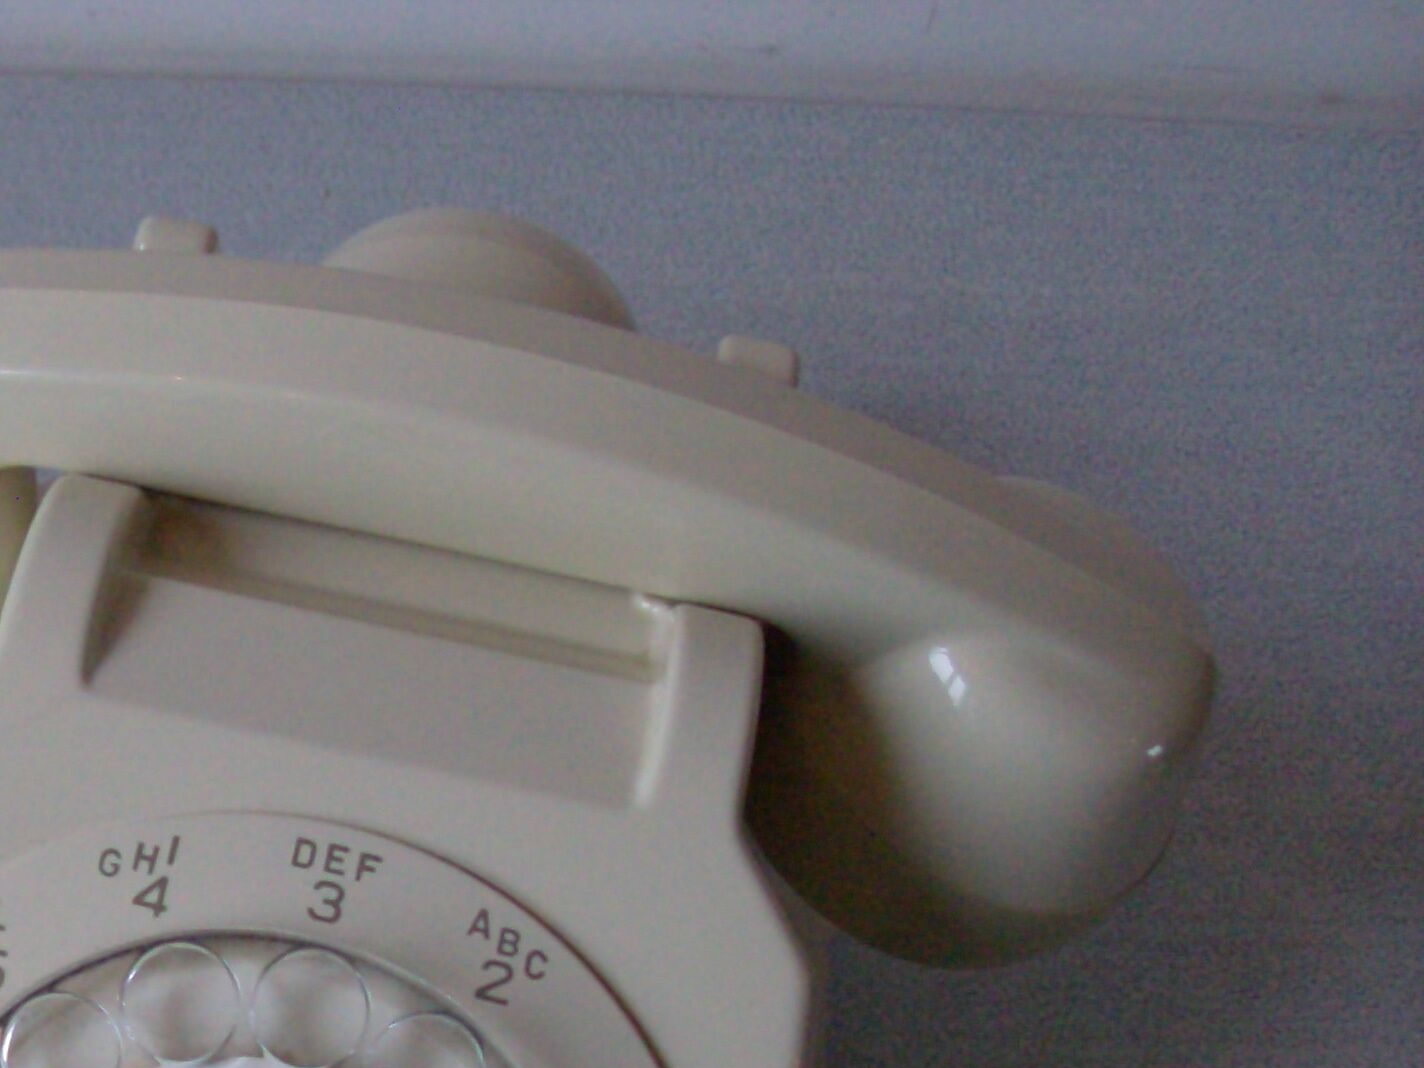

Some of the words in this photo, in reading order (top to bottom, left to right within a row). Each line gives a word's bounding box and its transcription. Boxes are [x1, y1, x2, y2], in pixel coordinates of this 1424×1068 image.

[132, 876, 169, 917] 4
[307, 880, 345, 924] 3
[474, 959, 514, 1006] 2
